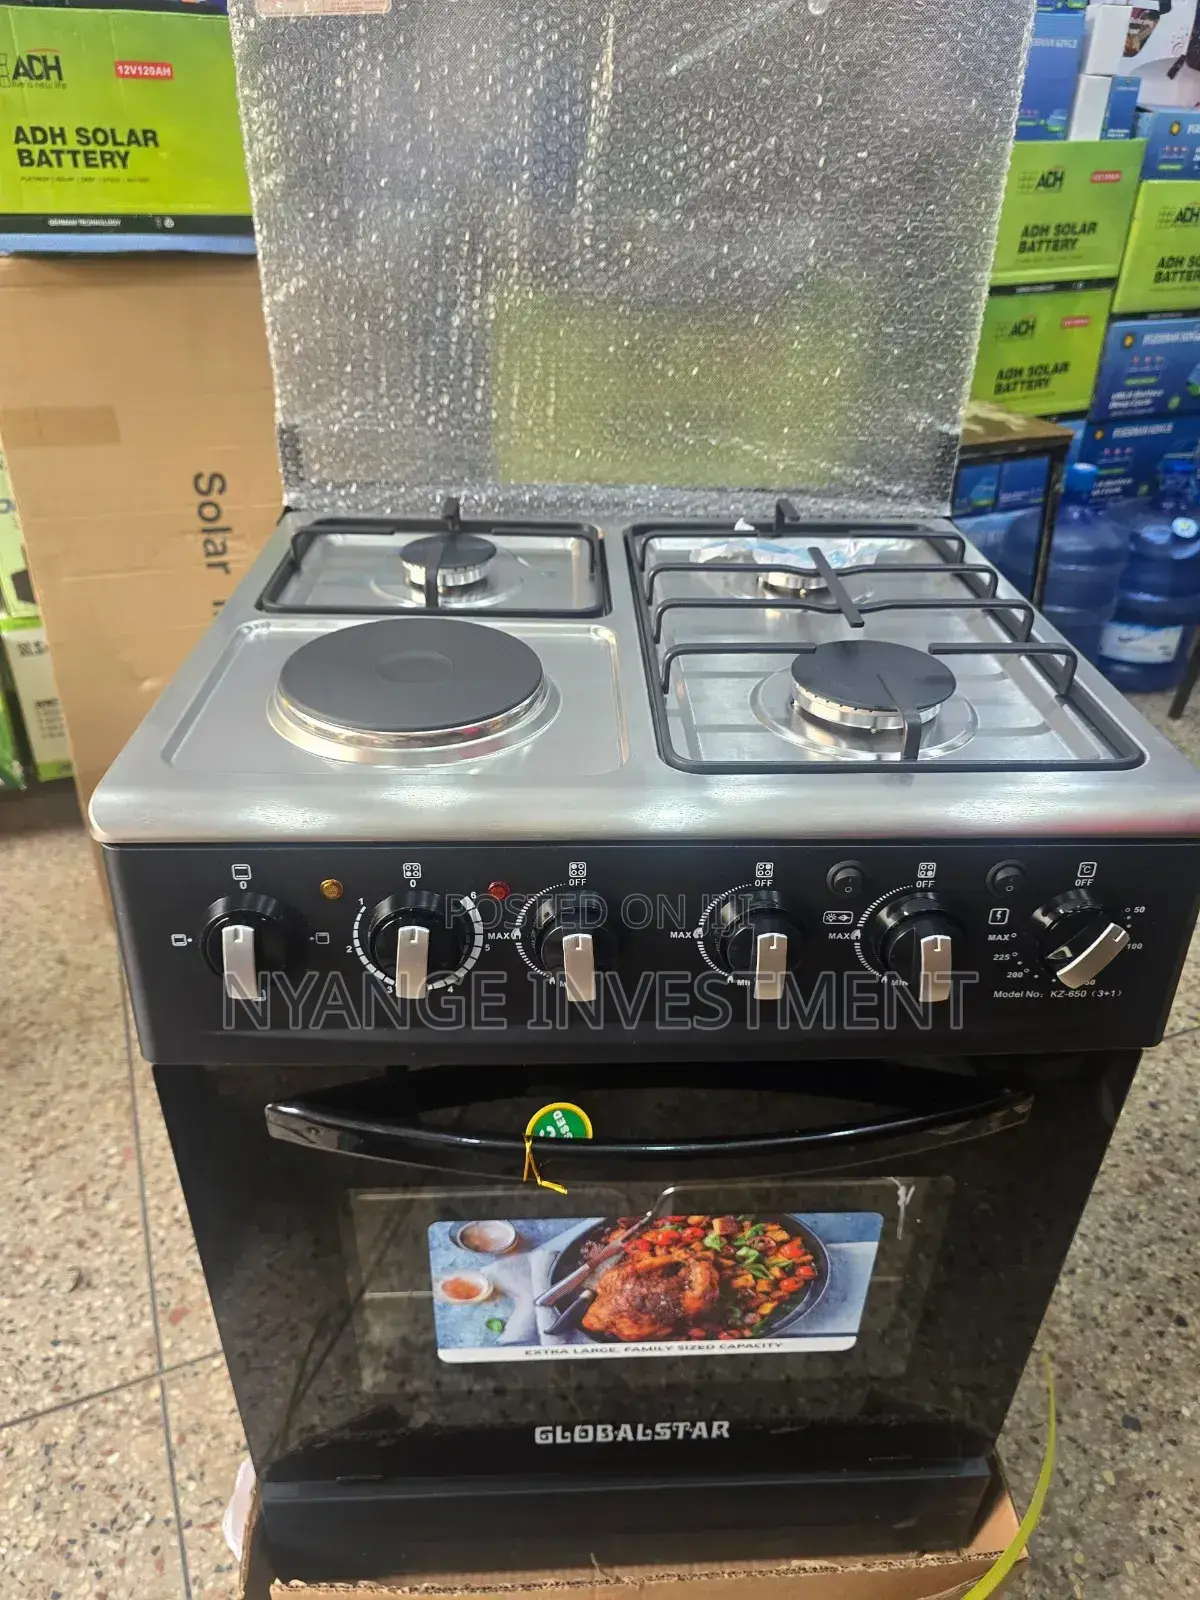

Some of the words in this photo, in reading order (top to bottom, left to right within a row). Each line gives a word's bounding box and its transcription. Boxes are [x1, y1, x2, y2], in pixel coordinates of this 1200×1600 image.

[12, 54, 64, 81] ADH
[14, 125, 67, 146] ADH
[75, 126, 160, 148] SOLAR
[17, 148, 130, 170] BATTERY
[1020, 224, 1050, 238] ADH
[1053, 221, 1098, 236] SOLAR
[1017, 238, 1079, 254] BATTERY
[1156, 255, 1185, 269] ADH
[996, 366, 1024, 381] ADH
[1025, 360, 1070, 378] SOLAR
[993, 378, 1051, 396] BATTERY
[193, 471, 232, 575] Solar
[568, 878, 587, 886] OFF
[754, 879, 773, 887] OFF
[915, 880, 935, 888] OFF
[1074, 879, 1094, 887] OFF
[470, 891, 477, 900] 6
[358, 897, 364, 905] 1
[487, 932, 510, 940] MAX
[670, 931, 692, 939] MAX
[828, 932, 850, 940] MAX
[346, 945, 353, 953] 2
[386, 986, 393, 994] 3
[447, 985, 454, 994] 4
[993, 990, 1023, 998] Model
[1050, 990, 1087, 998] KZ-650
[624, 1345, 673, 1353] FAMILY
[678, 1343, 715, 1351] SIZED
[719, 1341, 782, 1349] CAPACITY
[534, 1420, 730, 1445] GLOBALSTAR
